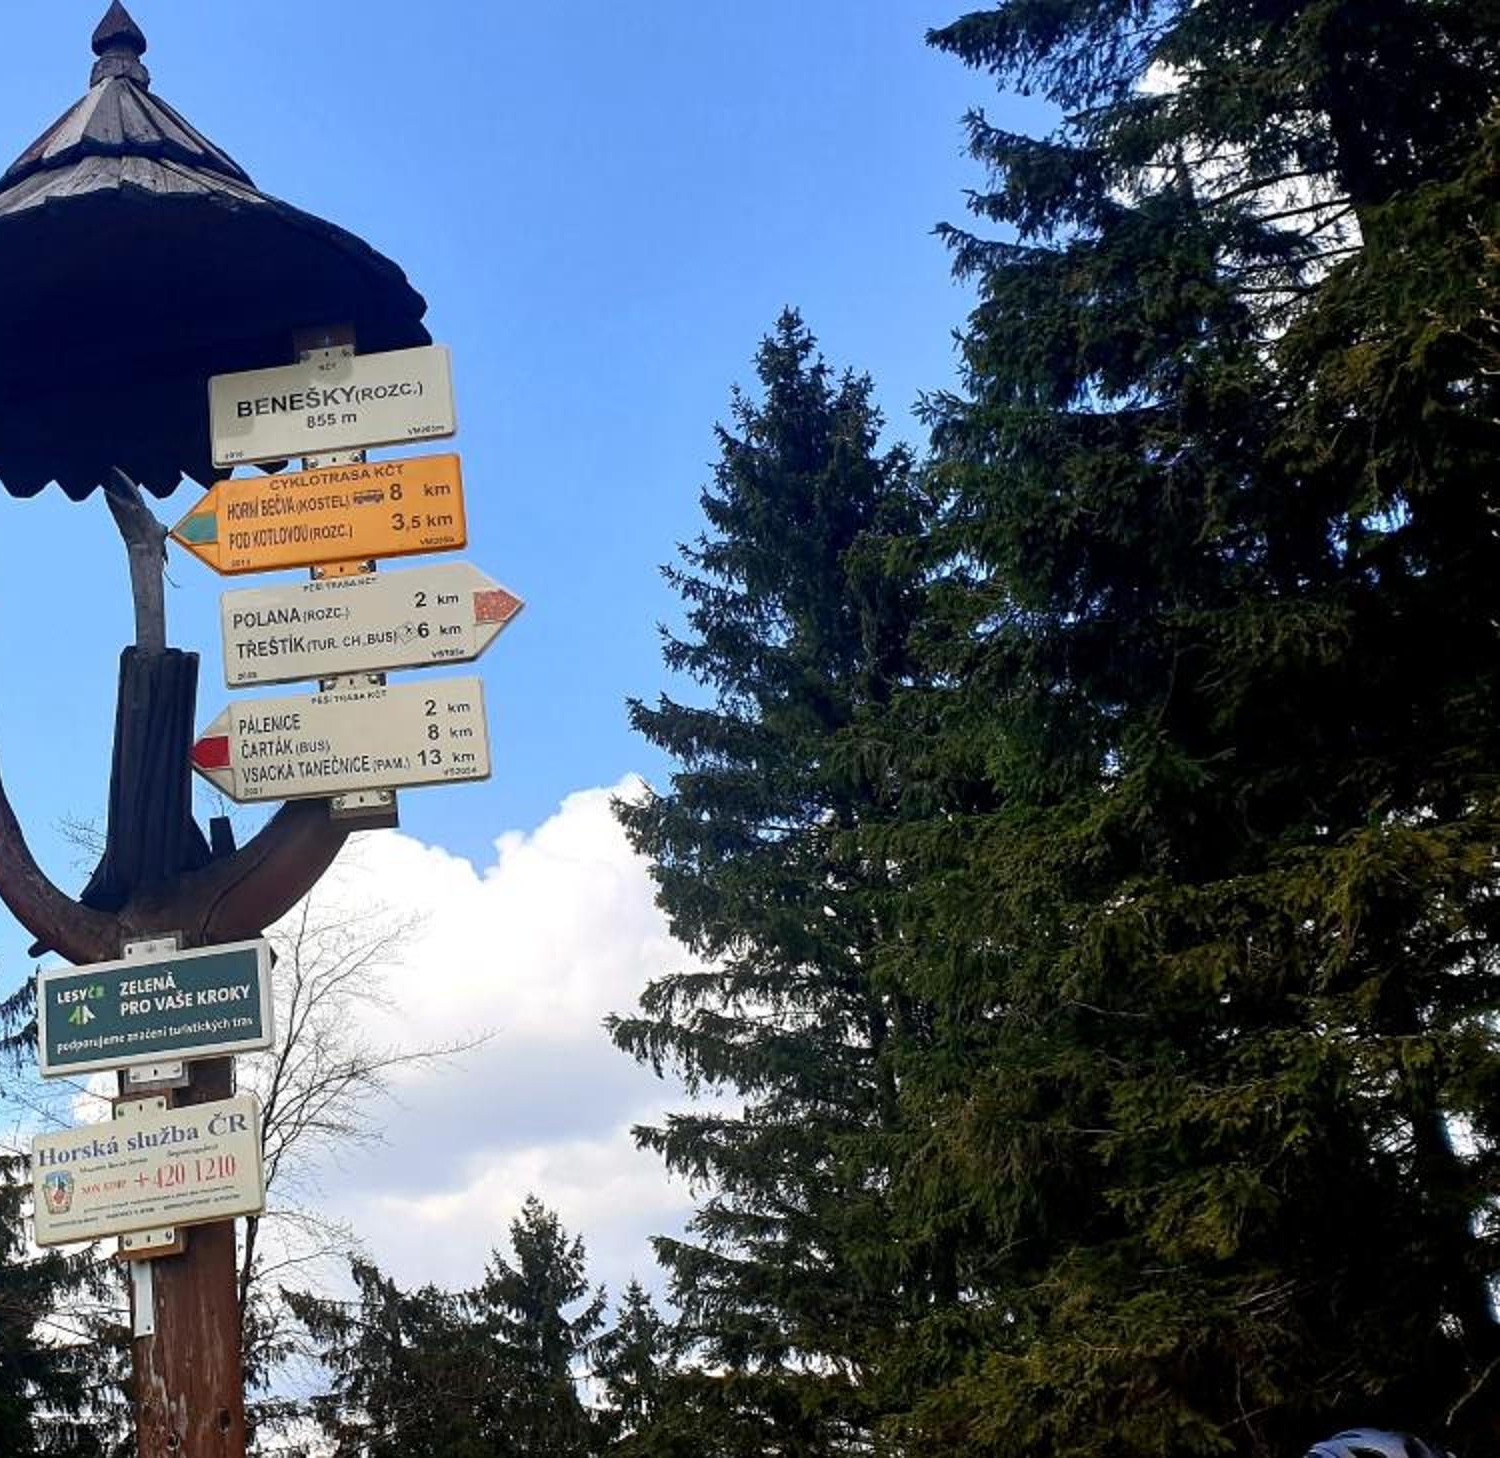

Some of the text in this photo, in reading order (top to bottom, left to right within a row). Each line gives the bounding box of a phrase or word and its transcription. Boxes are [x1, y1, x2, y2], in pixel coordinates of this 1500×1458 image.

[307, 412, 357, 429] 855 m
[269, 463, 404, 490] CYKLOTRASA KČT
[227, 496, 259, 520] HORNÍ
[390, 482, 402, 501] 8
[423, 483, 451, 497] km
[229, 531, 251, 550] POD
[391, 512, 421, 532] 3,5
[426, 514, 453, 528] km
[414, 591, 427, 609] 2
[437, 593, 459, 606] km
[417, 621, 430, 639] 6
[439, 624, 462, 636] km
[239, 699, 470, 736] PÁLENICE 2 km
[427, 723, 440, 741] 8
[449, 726, 473, 739] km
[241, 760, 295, 784] VSACKÁ
[417, 748, 443, 767] 13
[451, 751, 476, 763] km
[120, 971, 176, 997] ZELENÁ
[121, 983, 251, 1017] PRO VAŠE KROKY
[57, 1034, 125, 1056] podporujeme
[233, 1016, 254, 1028] tras
[38, 1136, 120, 1168] Horská
[126, 1125, 200, 1152] služba
[208, 1111, 249, 1137] ČR
[195, 1152, 236, 1183] 1210
